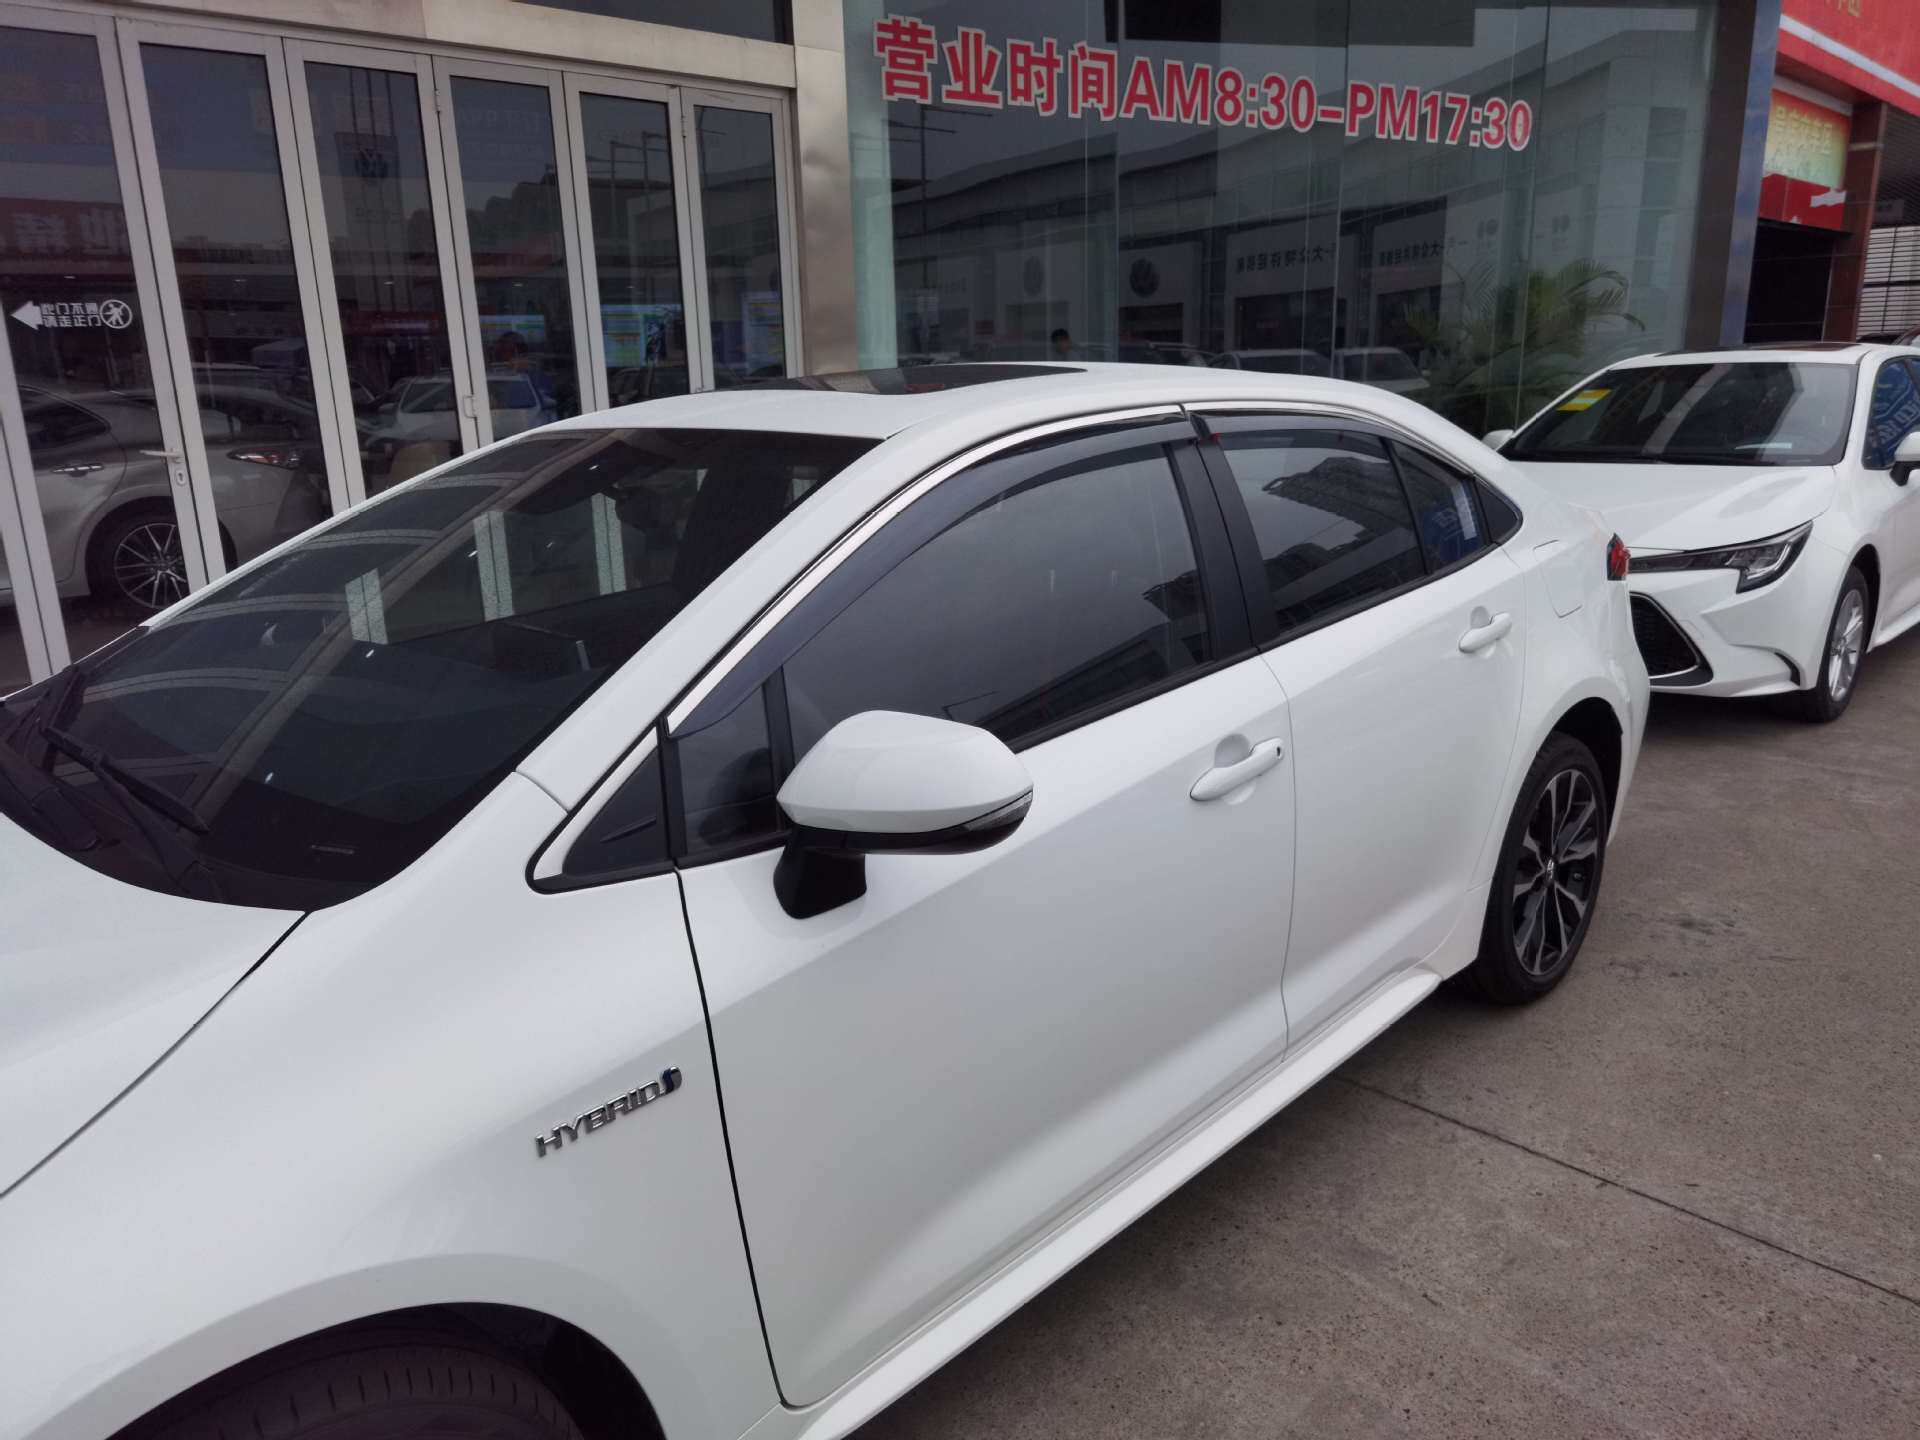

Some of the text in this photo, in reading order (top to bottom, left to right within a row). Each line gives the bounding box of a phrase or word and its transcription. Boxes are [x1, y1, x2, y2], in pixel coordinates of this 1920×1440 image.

[873, 14, 1533, 152] 营业时间AM8:30-PM17:30
[42, 314, 102, 327] 请走正门
[535, 1079, 661, 1159] HYBRID
